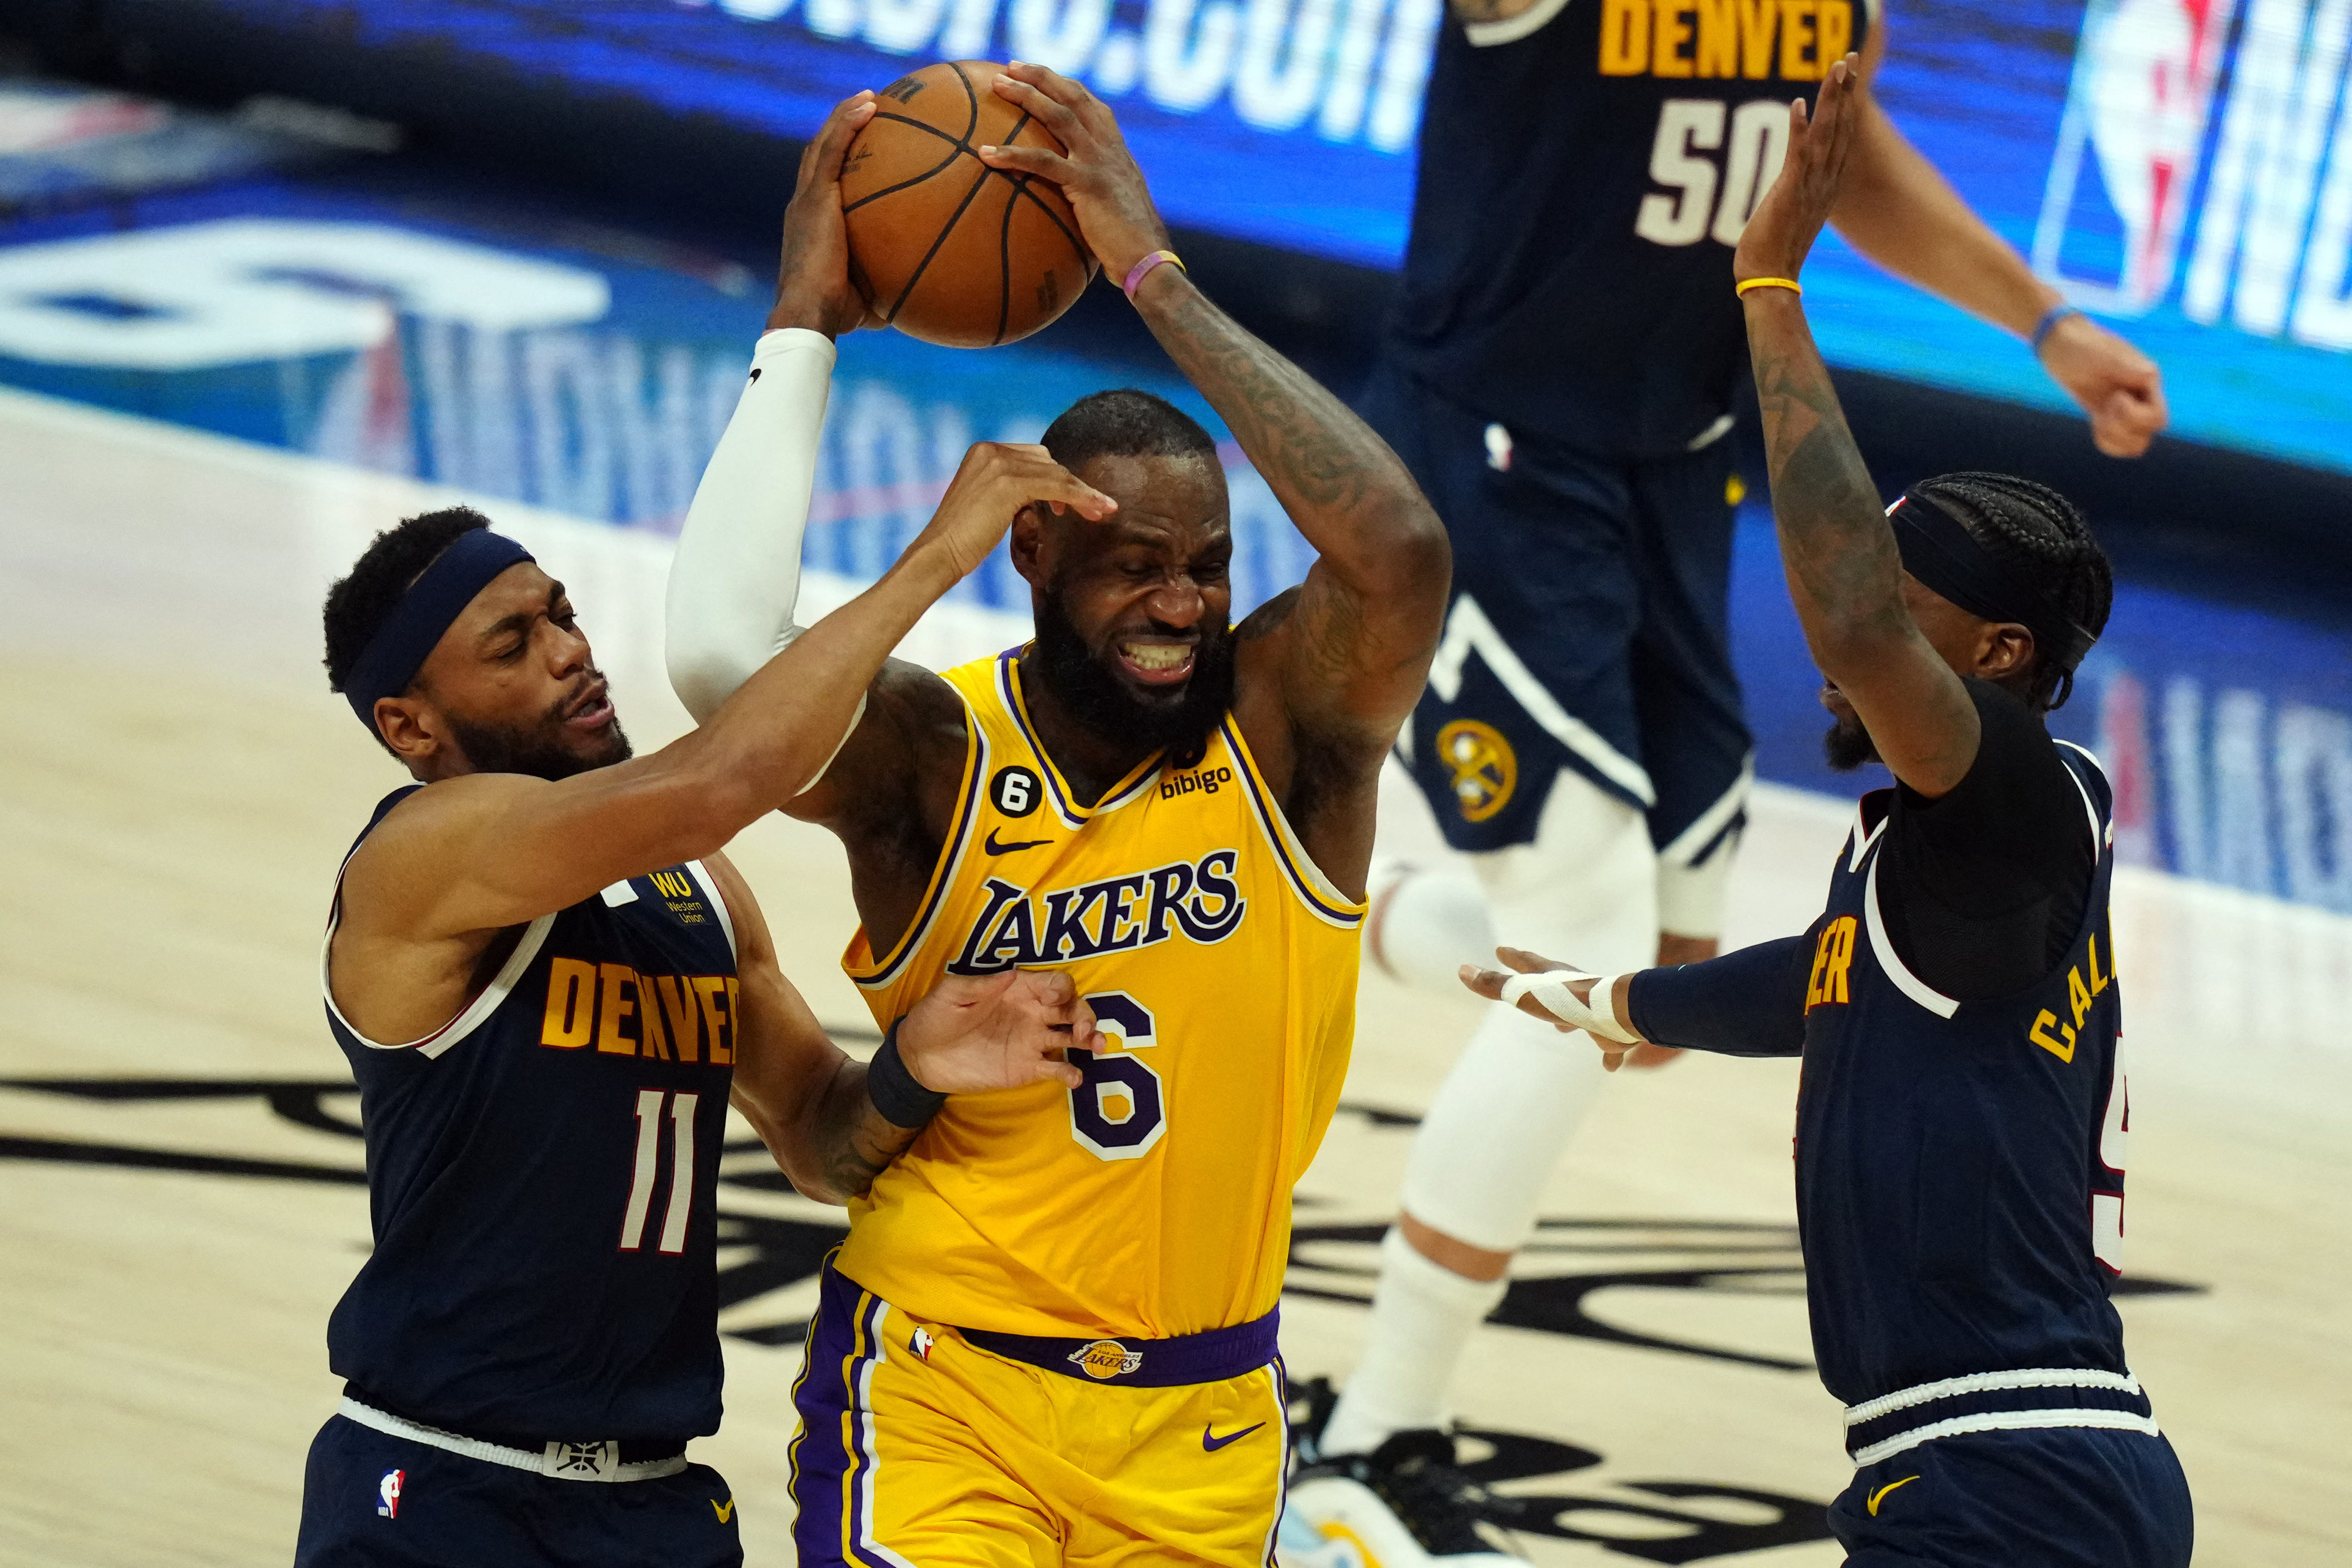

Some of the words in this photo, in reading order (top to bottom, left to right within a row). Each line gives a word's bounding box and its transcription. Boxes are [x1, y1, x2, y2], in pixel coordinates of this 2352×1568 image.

[1597, 0, 1853, 82] DENVER
[1634, 97, 1792, 249] 50
[1001, 772, 1031, 812] 6
[1160, 767, 1231, 800] bibigo
[647, 871, 692, 898] WU
[665, 901, 703, 912] Western
[944, 848, 1248, 977] LAKERS
[678, 911, 706, 924] Union
[1803, 914, 1859, 1018] ER
[2029, 907, 2116, 1064] CAL
[1063, 989, 1168, 1162] 6
[617, 1086, 700, 1256] 11
[1075, 1347, 1143, 1372] LAKERS
[378, 1506, 389, 1517] NBA
